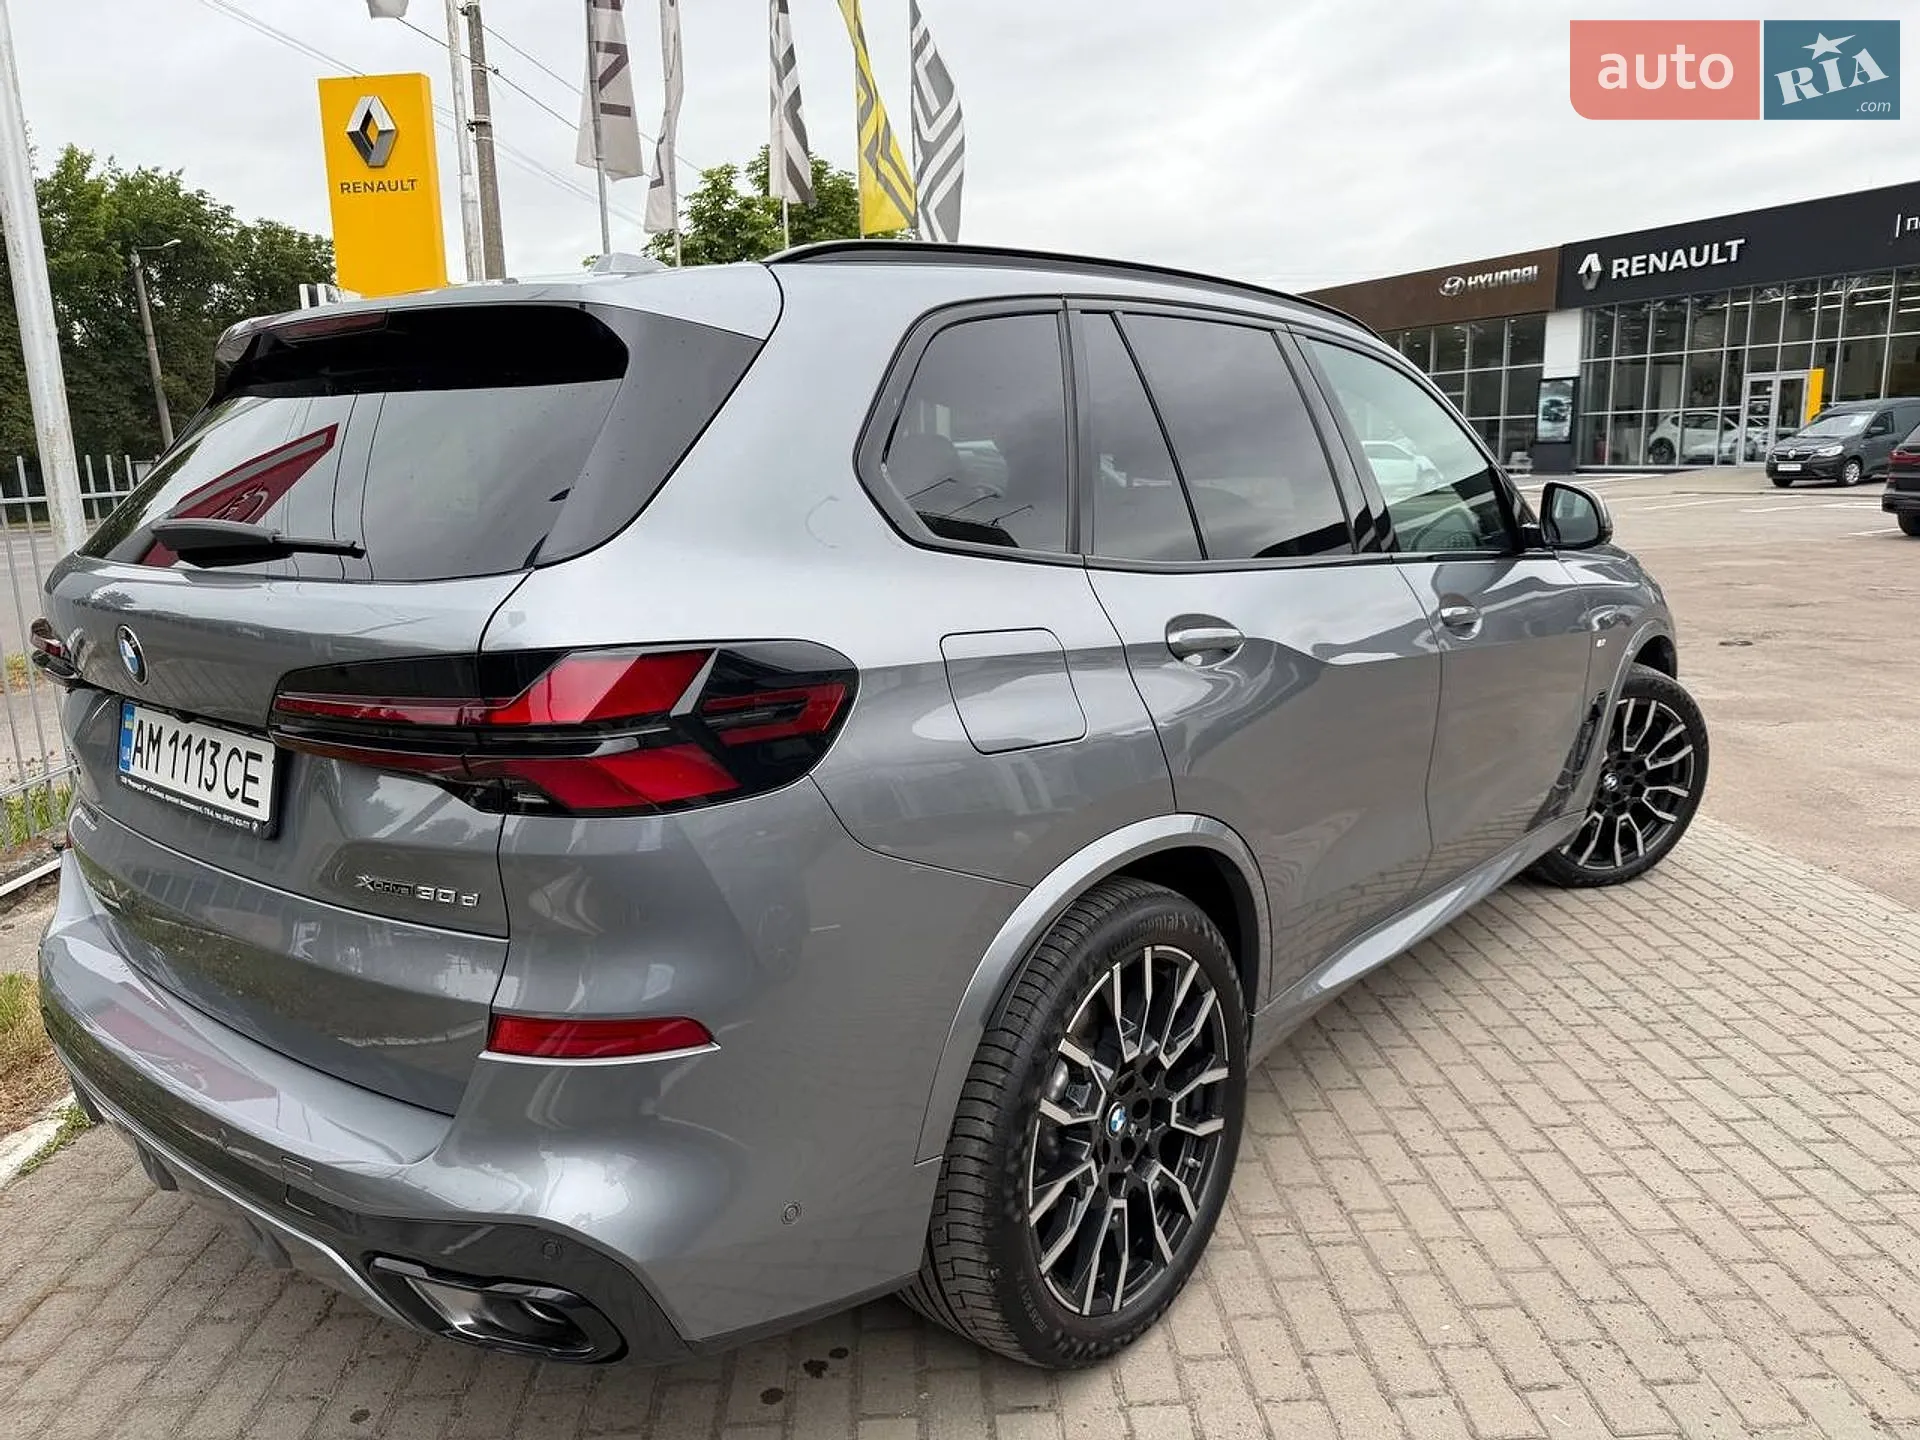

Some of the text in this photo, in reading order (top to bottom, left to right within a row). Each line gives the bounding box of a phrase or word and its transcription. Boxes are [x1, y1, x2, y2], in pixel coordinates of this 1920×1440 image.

[340, 178, 417, 194] RENAULT
[1611, 238, 1746, 279] RENAULT
[1467, 264, 1538, 291] HYUNDAI
